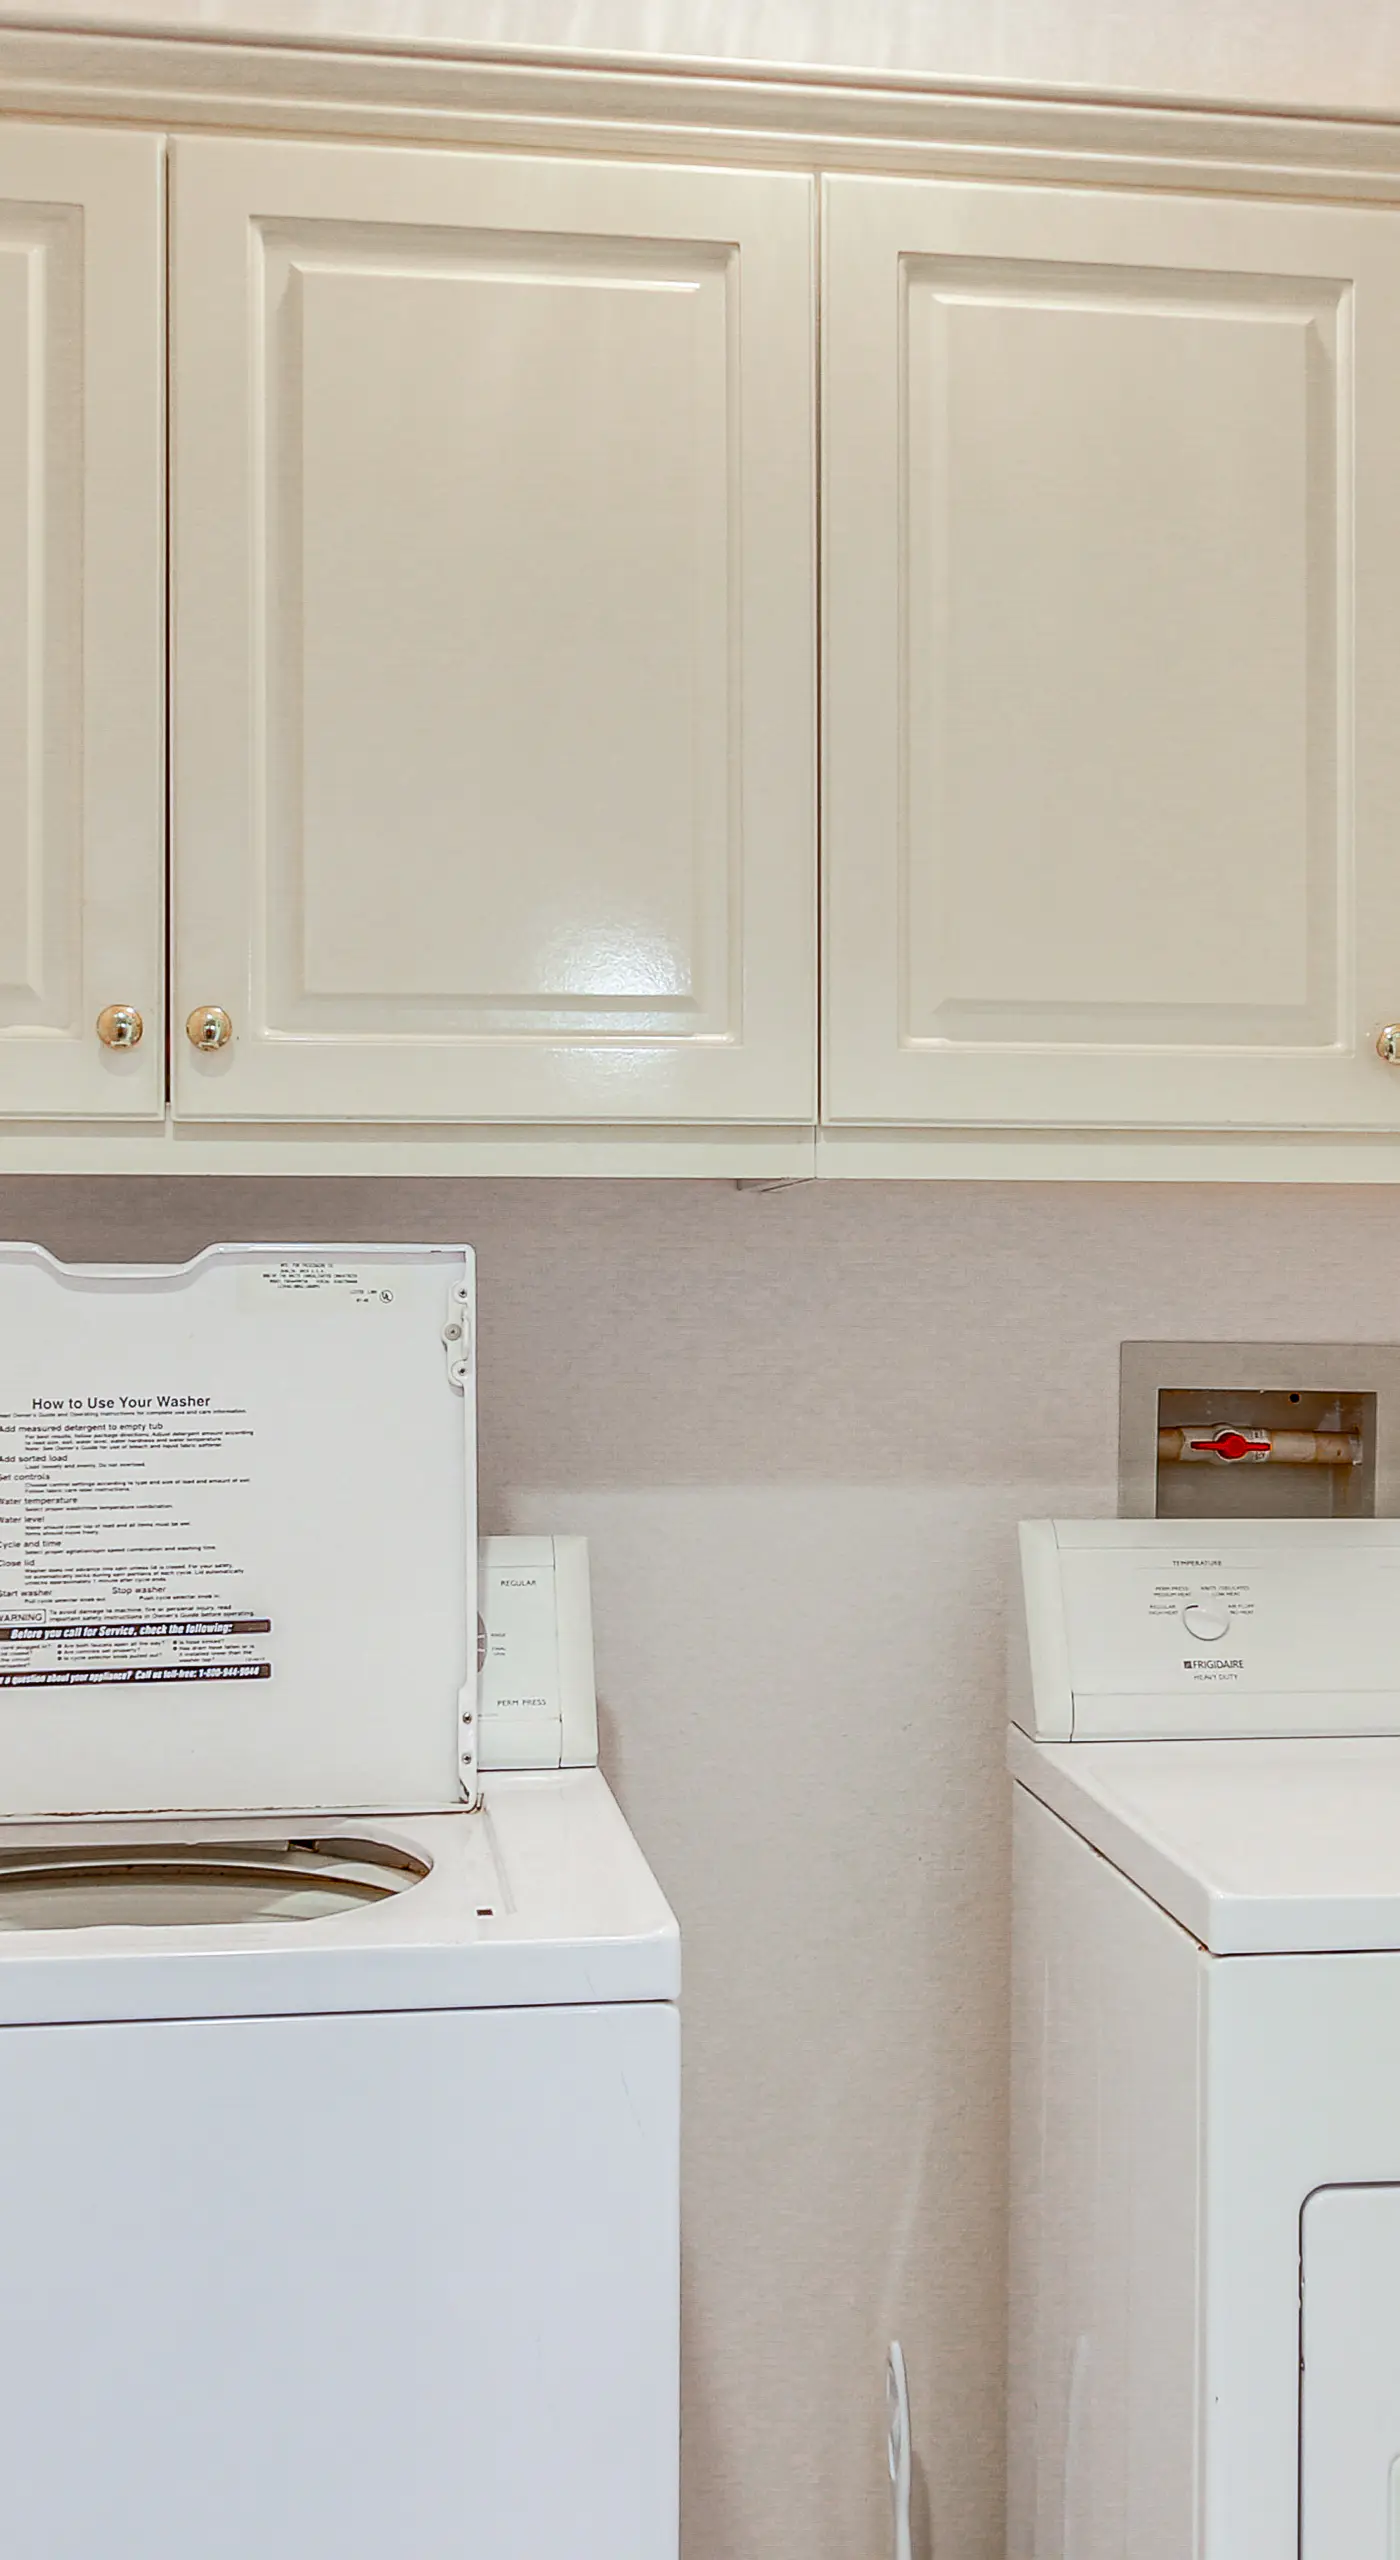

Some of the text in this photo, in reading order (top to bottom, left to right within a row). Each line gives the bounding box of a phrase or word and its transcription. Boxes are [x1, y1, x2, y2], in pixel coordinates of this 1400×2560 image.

[32, 1395, 211, 1409] How to Use Your Washer
[64, 1424, 106, 1433] detergent
[10, 1623, 233, 1639] Before you call for Service, check the following:
[1193, 1660, 1244, 1669] FRIGIDAIRE
[12, 1674, 46, 1684] question
[48, 1673, 70, 1682] about
[70, 1674, 91, 1683] your
[90, 1671, 133, 1681] appliance?
[134, 1670, 152, 1679] Call
[153, 1670, 162, 1678] us
[163, 1668, 197, 1678] toll-free:
